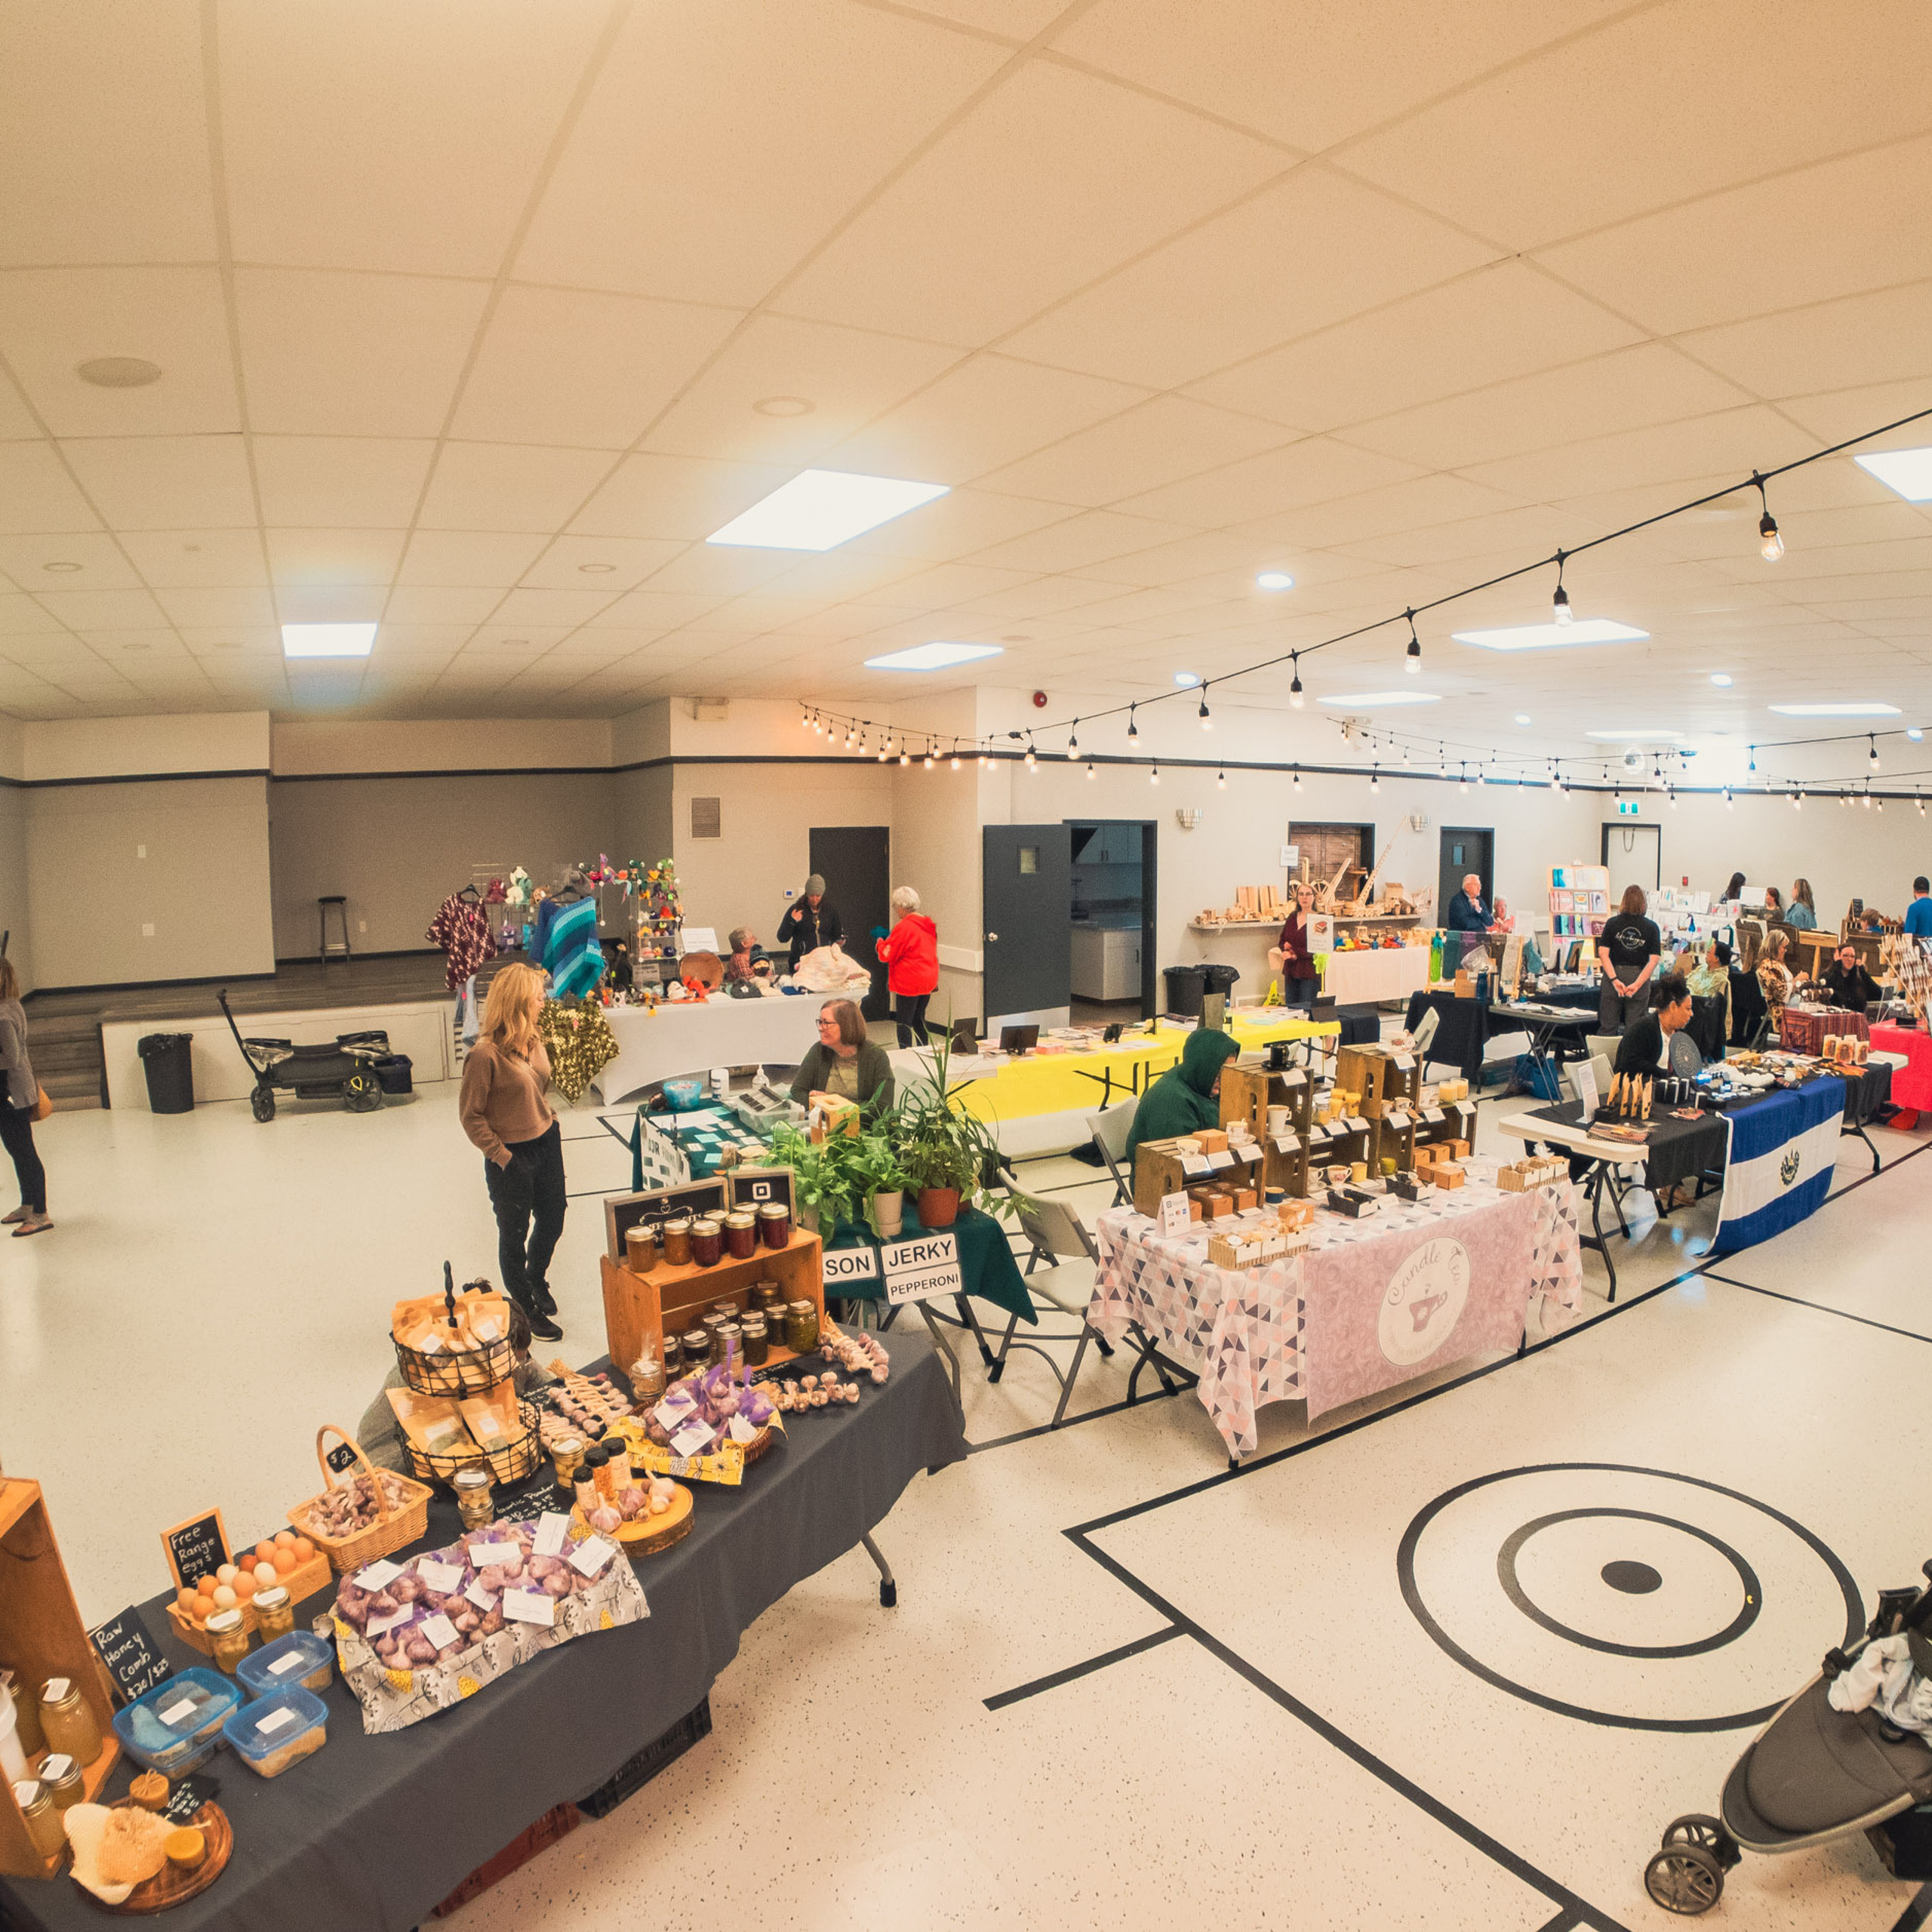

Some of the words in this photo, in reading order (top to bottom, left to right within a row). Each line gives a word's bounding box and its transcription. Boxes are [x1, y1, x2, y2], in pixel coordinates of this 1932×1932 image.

[826, 1254, 870, 1276] SON
[888, 1239, 952, 1267] JERKY
[891, 1272, 959, 1297] PEPPERONI
[1388, 1242, 1441, 1306] Candle
[170, 1526, 202, 1551] Free
[177, 1537, 215, 1564] Range
[181, 1554, 212, 1574] eggs
[95, 1621, 123, 1651] Raw
[103, 1632, 146, 1668] Honey
[118, 1651, 152, 1682] Comb
